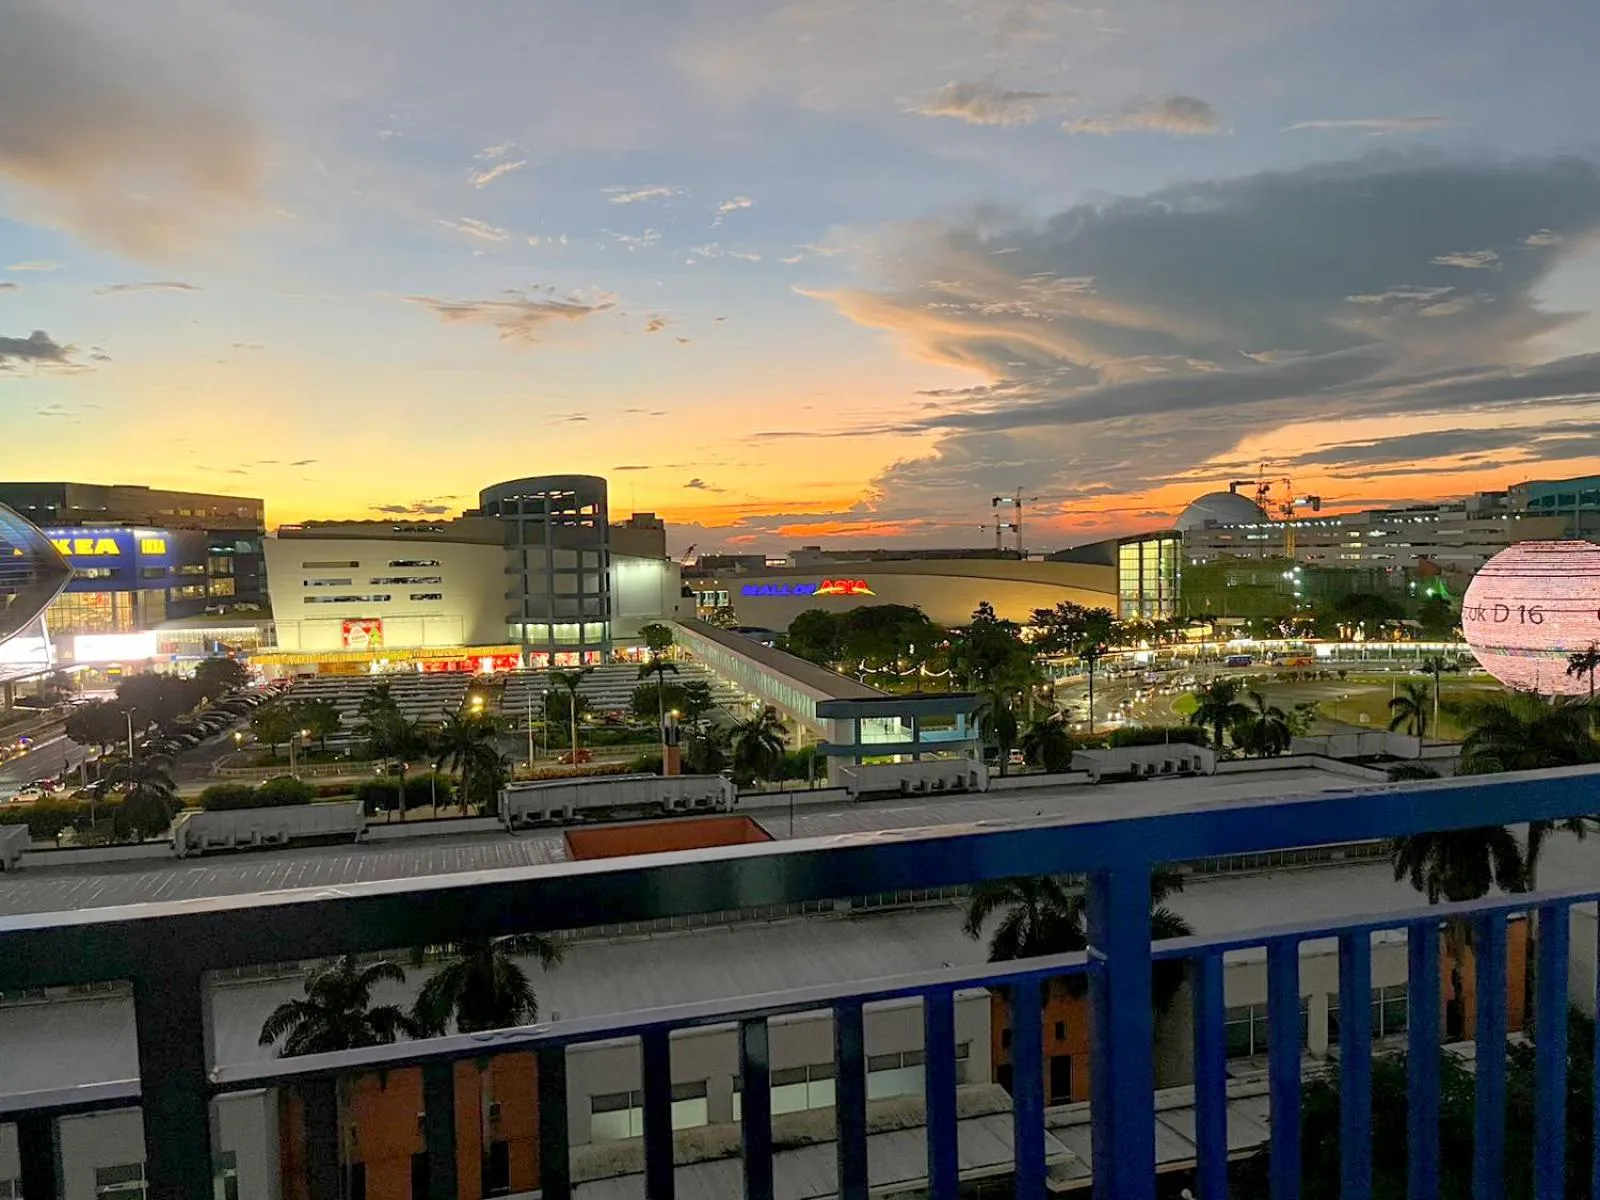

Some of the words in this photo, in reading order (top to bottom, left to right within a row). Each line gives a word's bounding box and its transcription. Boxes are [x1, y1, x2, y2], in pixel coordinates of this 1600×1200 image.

[49, 538, 120, 555] KEA
[741, 584, 790, 596] MALL
[793, 583, 816, 596] OF
[820, 579, 867, 596] ASIA
[1494, 604, 1509, 623] D
[1518, 604, 1544, 624] 16
